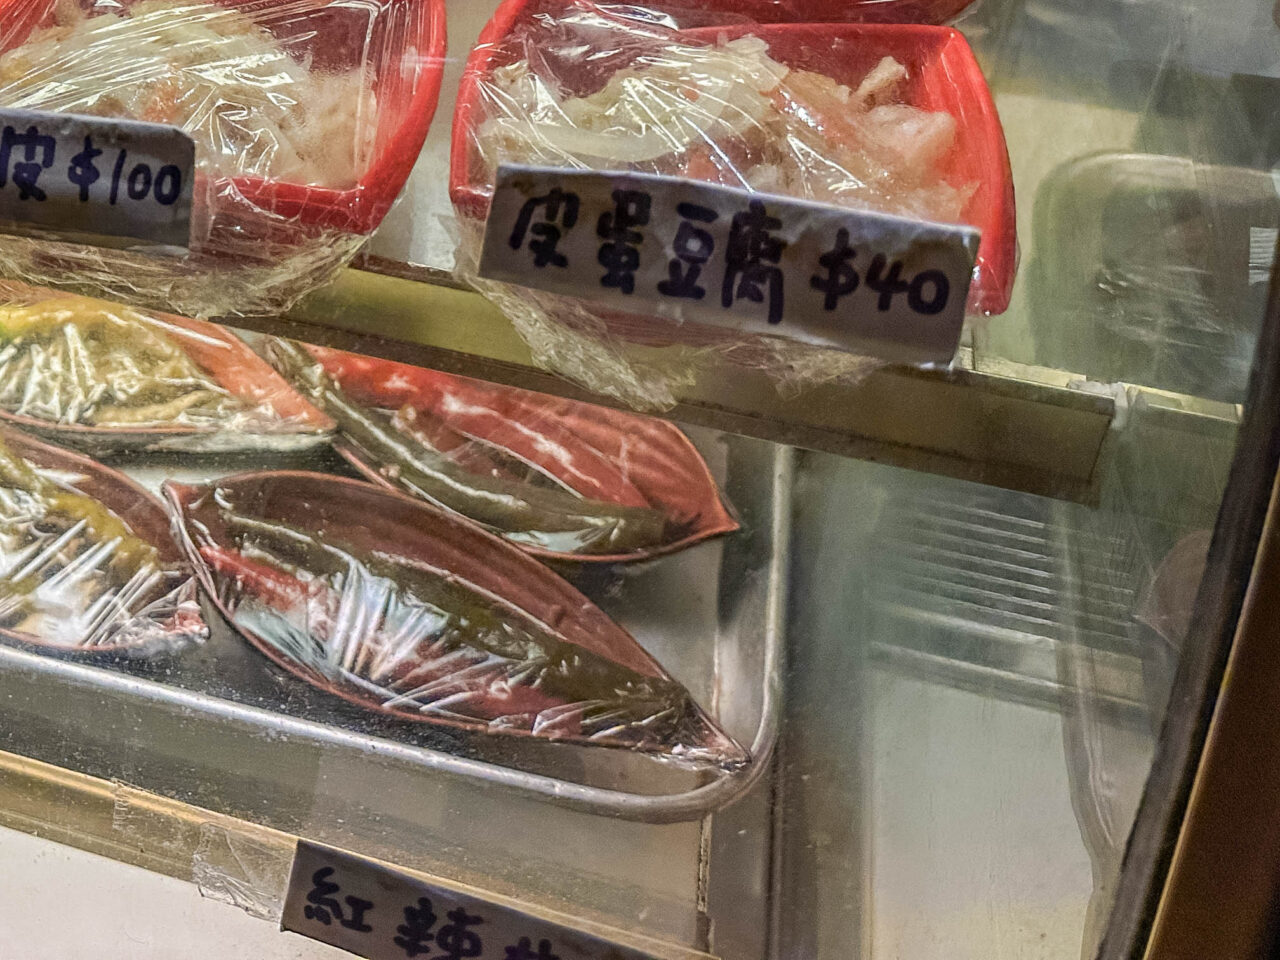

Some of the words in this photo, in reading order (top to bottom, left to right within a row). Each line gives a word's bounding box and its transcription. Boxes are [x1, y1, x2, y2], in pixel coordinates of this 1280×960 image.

[67, 135, 183, 206] $100
[508, 187, 785, 324] 皮蛋豆腐
[810, 227, 950, 315] $40
